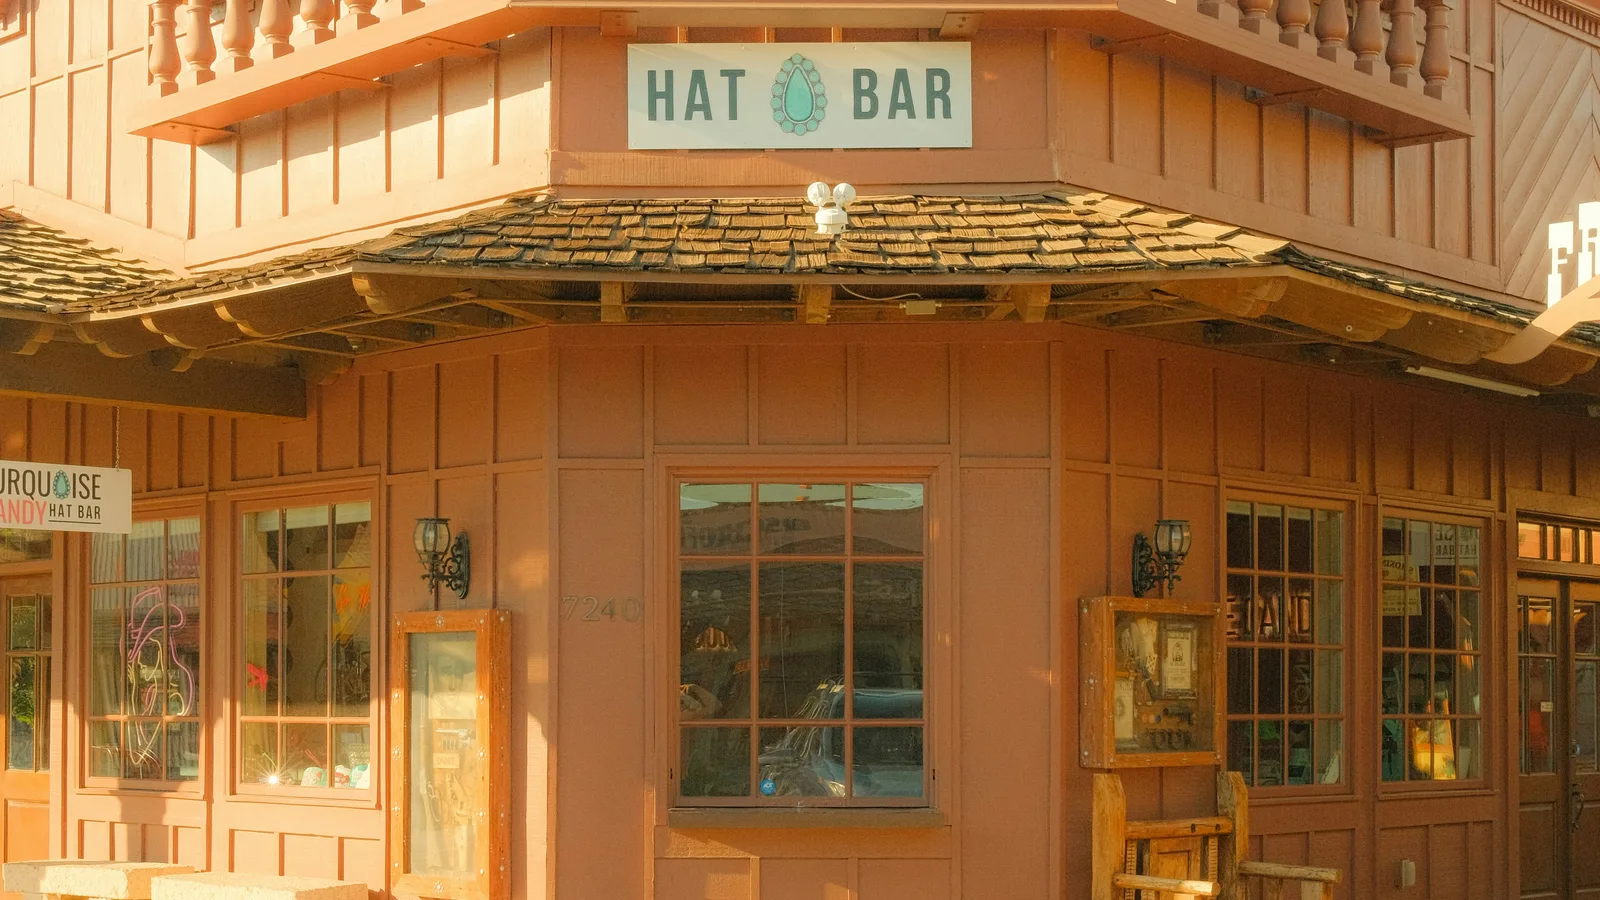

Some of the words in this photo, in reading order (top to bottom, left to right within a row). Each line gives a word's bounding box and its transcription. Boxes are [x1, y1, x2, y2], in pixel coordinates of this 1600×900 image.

[647, 69, 746, 121] HAT
[852, 68, 952, 120] BAR
[49, 503, 73, 518] HAT
[78, 505, 101, 520] BAR
[562, 595, 640, 621] 7240
